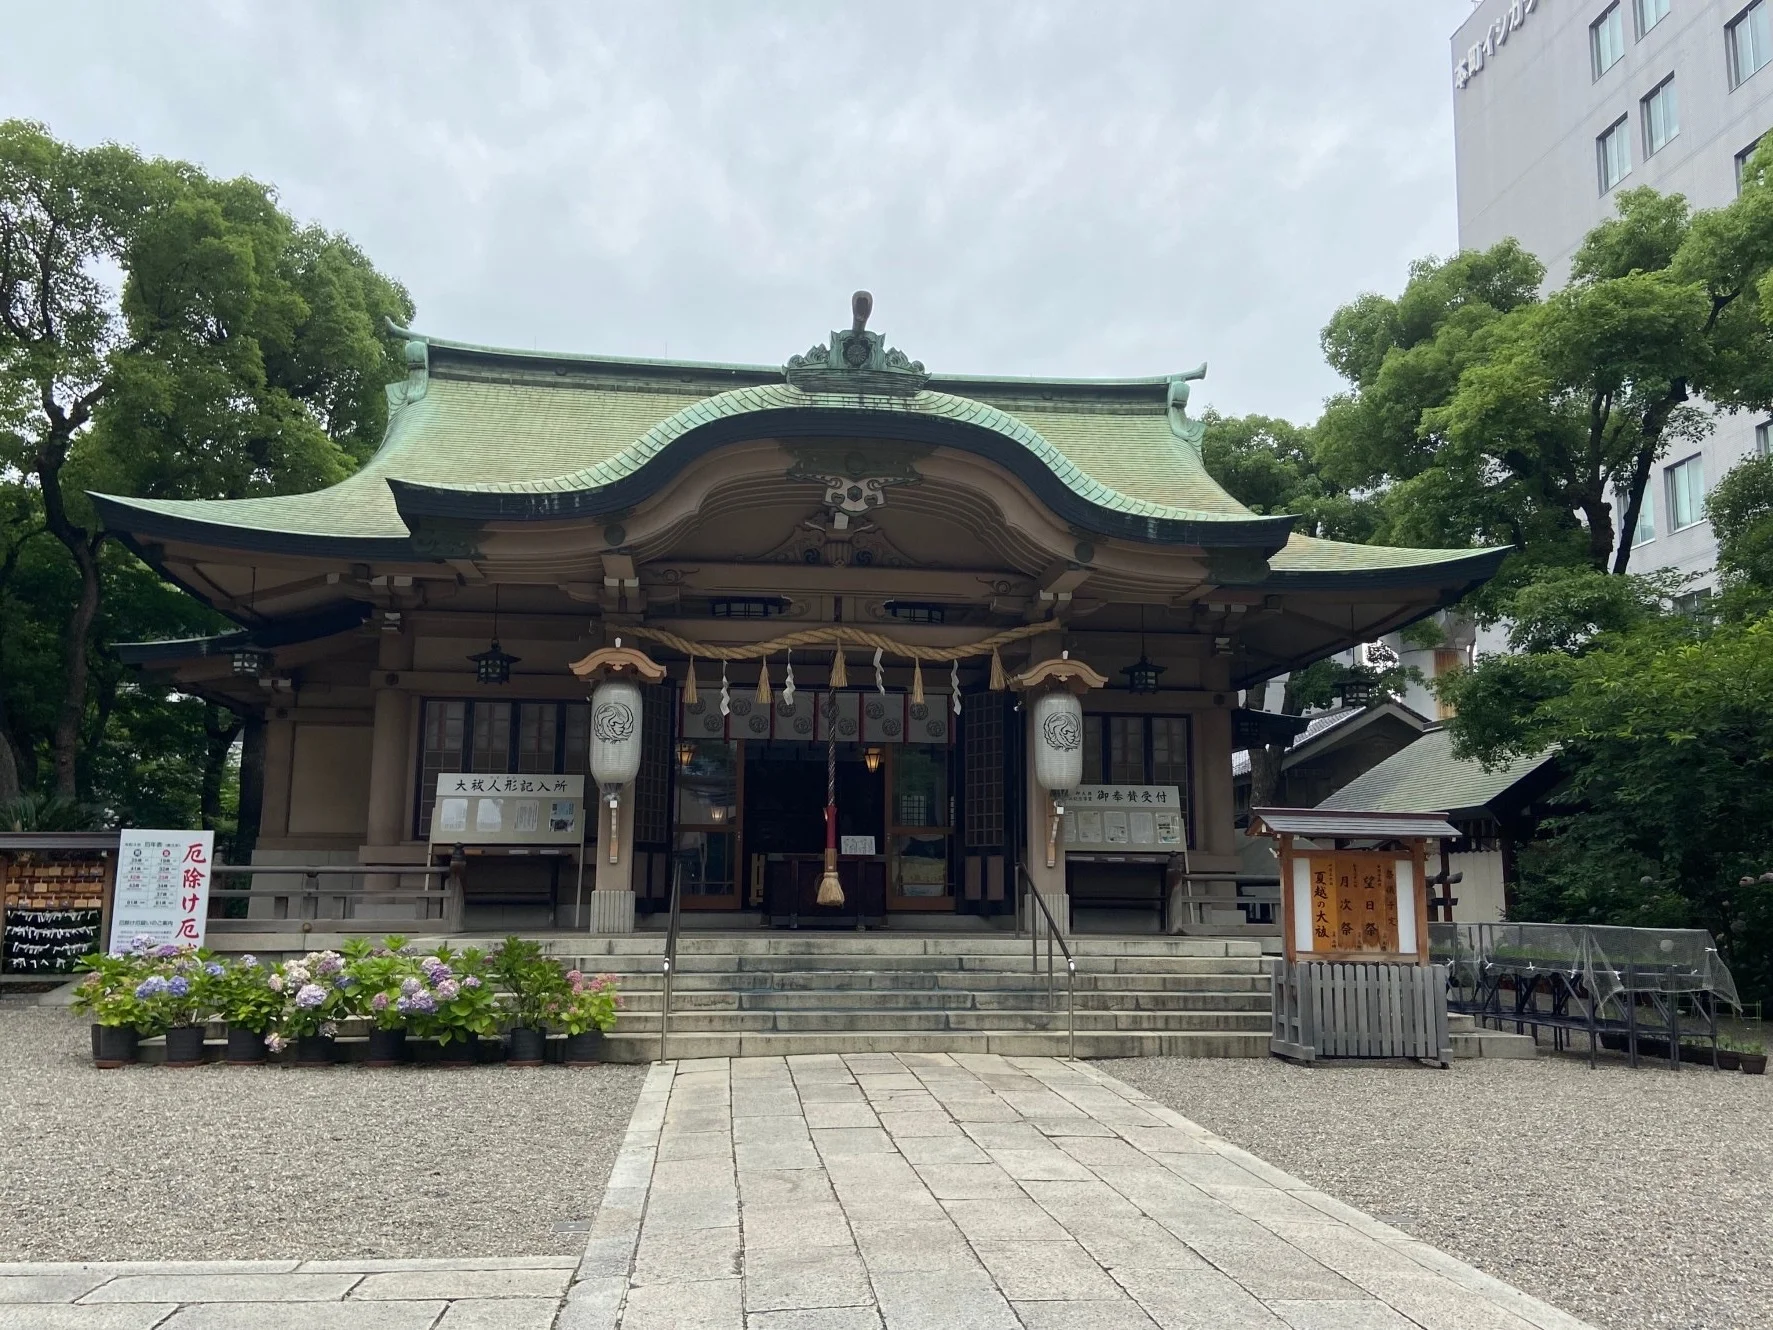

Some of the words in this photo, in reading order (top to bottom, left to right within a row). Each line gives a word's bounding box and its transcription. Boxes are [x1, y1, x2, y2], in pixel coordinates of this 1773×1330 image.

[454, 778, 568, 793] 大祓人形記入所
[1313, 871, 1330, 939] 夏越の大祓
[1339, 875, 1354, 937] 月次祭
[1363, 874, 1380, 937] 望日祭
